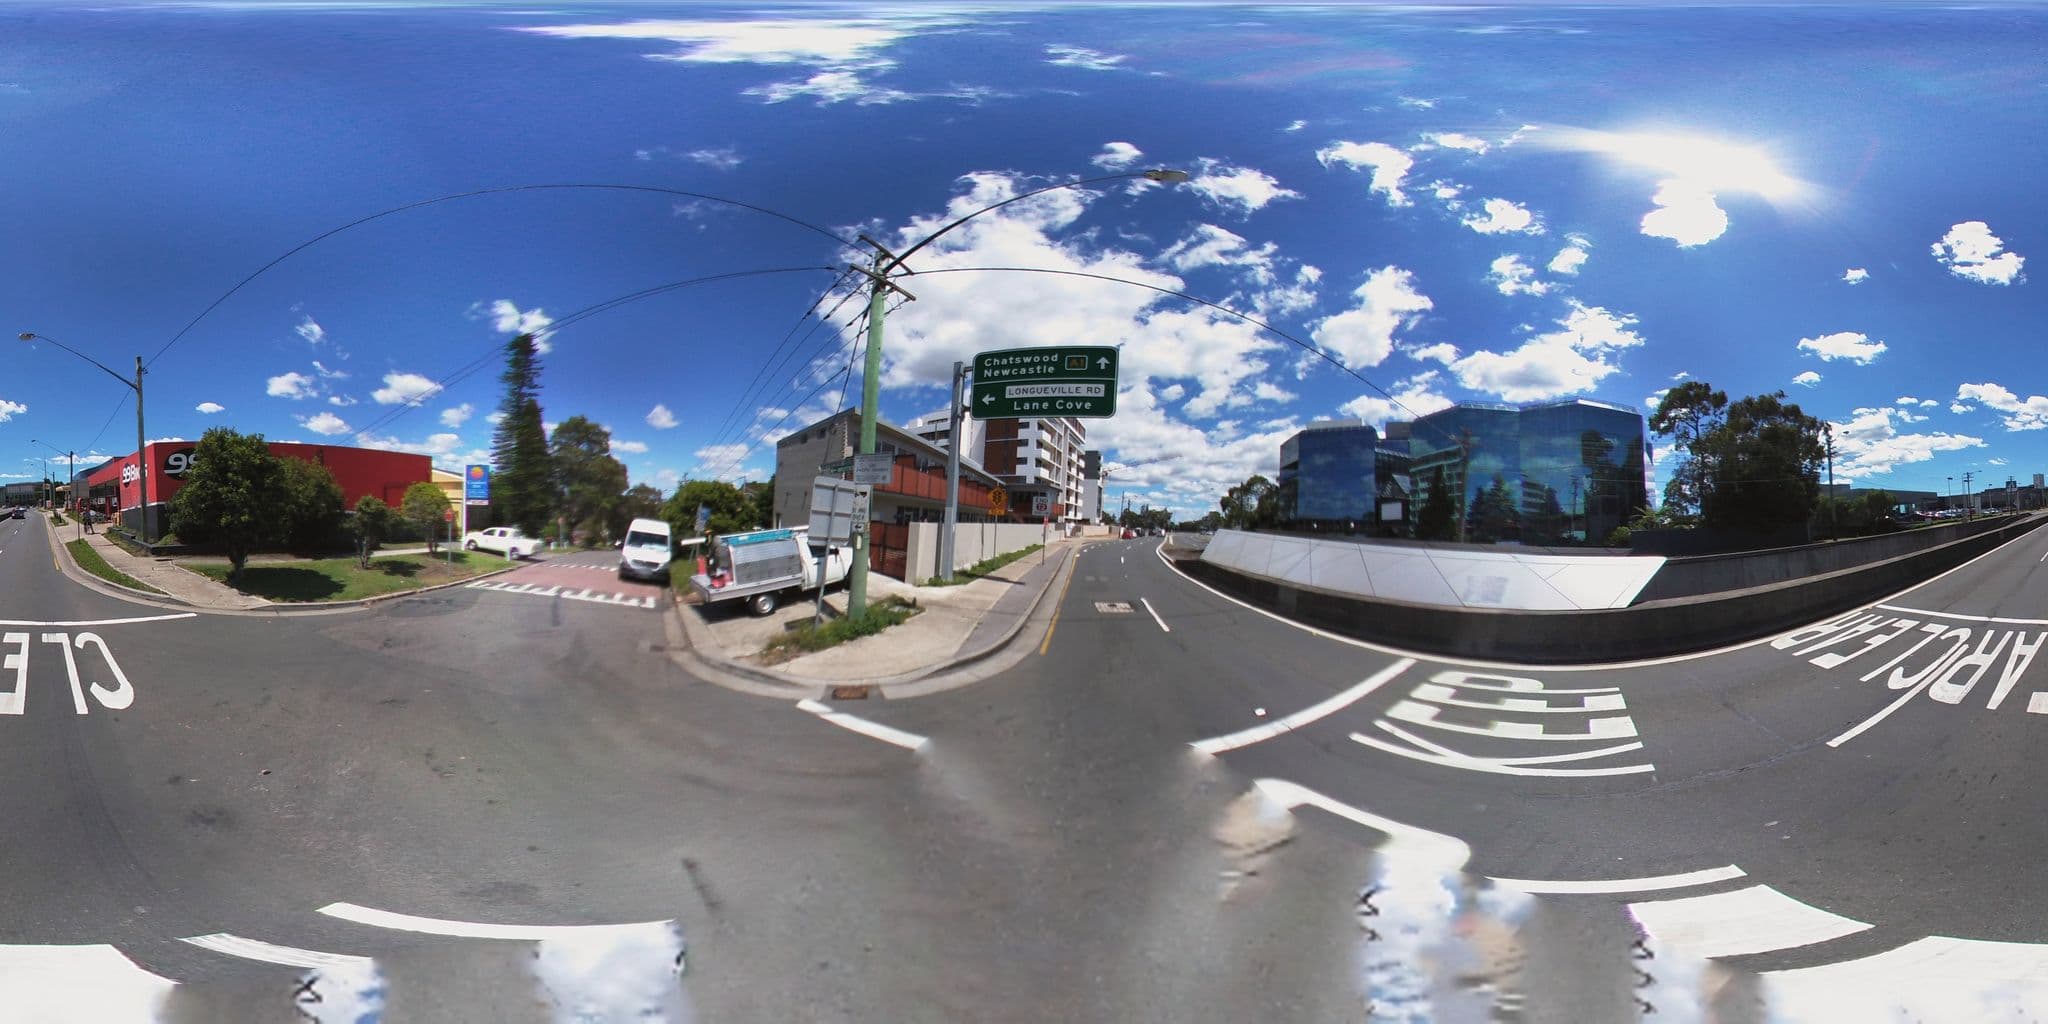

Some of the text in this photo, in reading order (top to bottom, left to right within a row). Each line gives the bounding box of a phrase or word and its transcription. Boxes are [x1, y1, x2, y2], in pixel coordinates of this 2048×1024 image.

[984, 353, 1059, 367] Chatswood
[983, 365, 1055, 378] Newcastle
[1008, 386, 1102, 396] LONGUEVILLE RD
[1013, 399, 1092, 411] Lane Cove
[1770, 611, 1972, 690] CLEAR
[1348, 671, 1656, 777] KEEP
